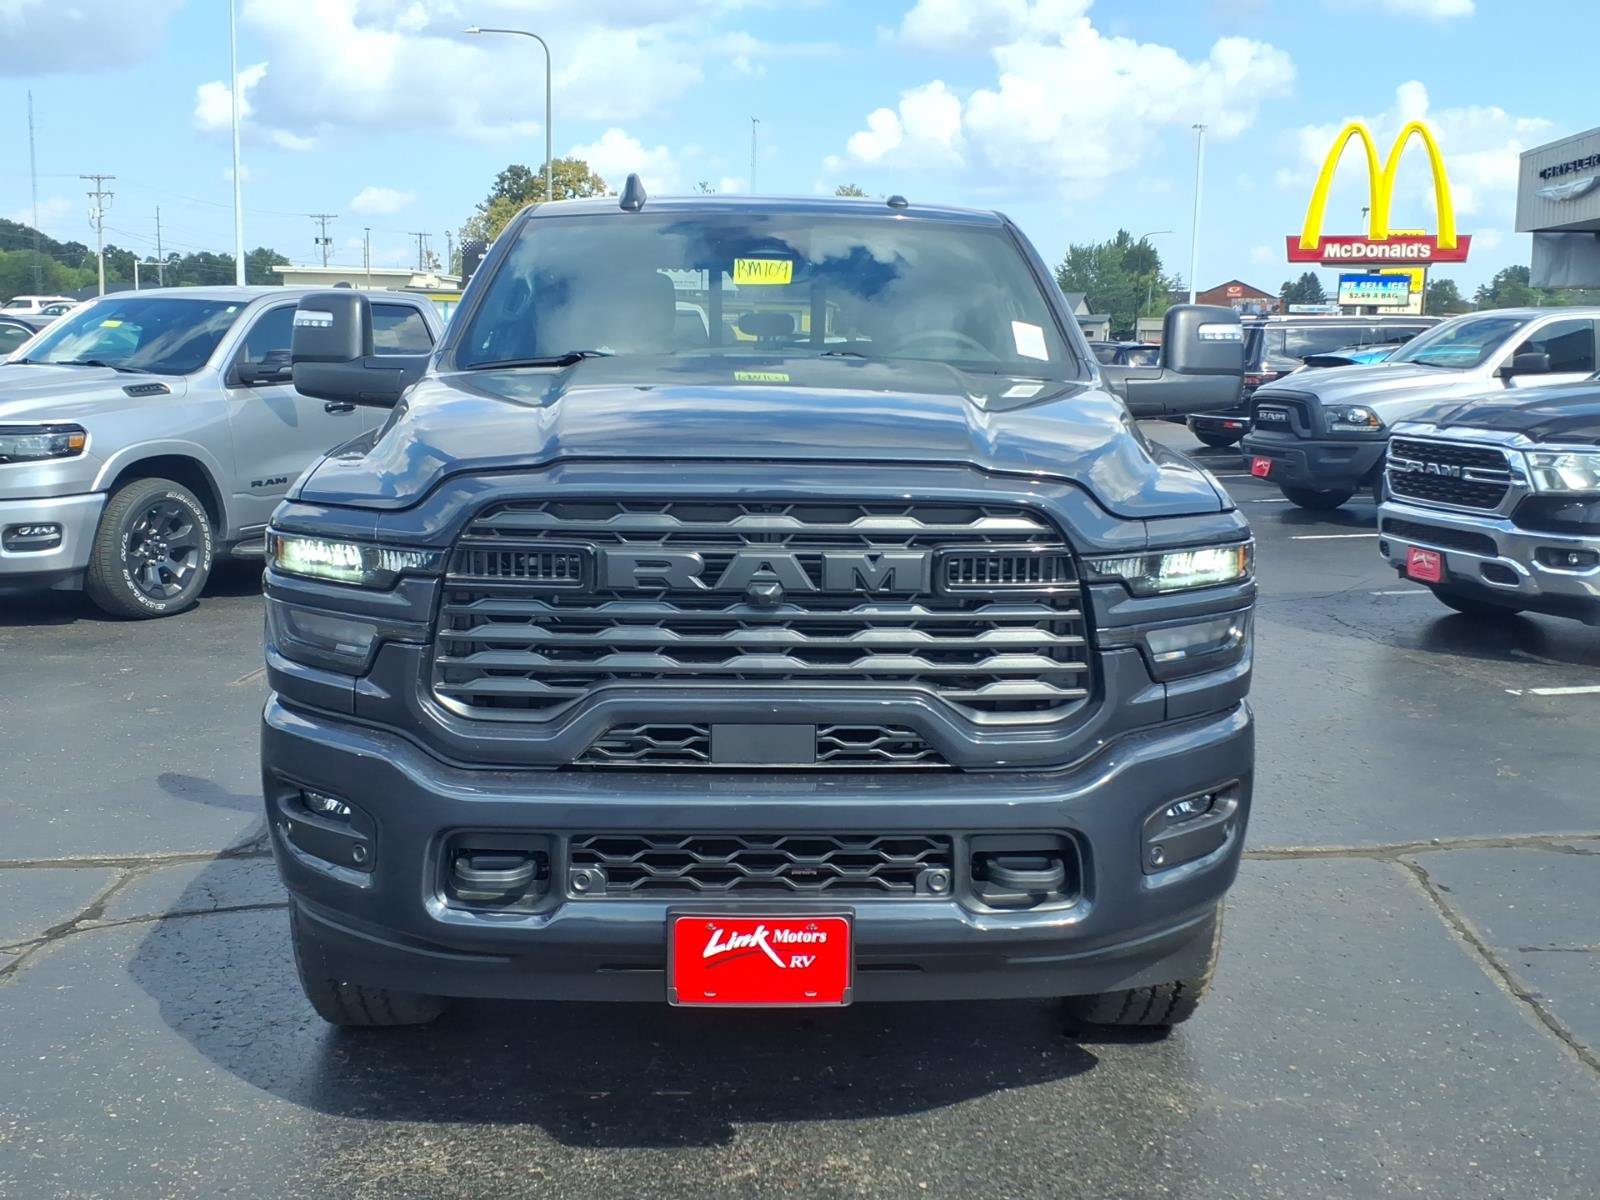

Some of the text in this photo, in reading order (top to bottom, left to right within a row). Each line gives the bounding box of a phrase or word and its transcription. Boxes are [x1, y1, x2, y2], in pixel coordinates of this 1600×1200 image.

[1324, 242, 1431, 258] McDonald's
[1359, 282, 1384, 291] SELL
[1259, 412, 1286, 422] RAM
[1406, 461, 1461, 478] RAM
[251, 477, 288, 487] RAM
[604, 550, 928, 592] RAM
[702, 924, 827, 969] Link Motors
[789, 955, 816, 968] RV
